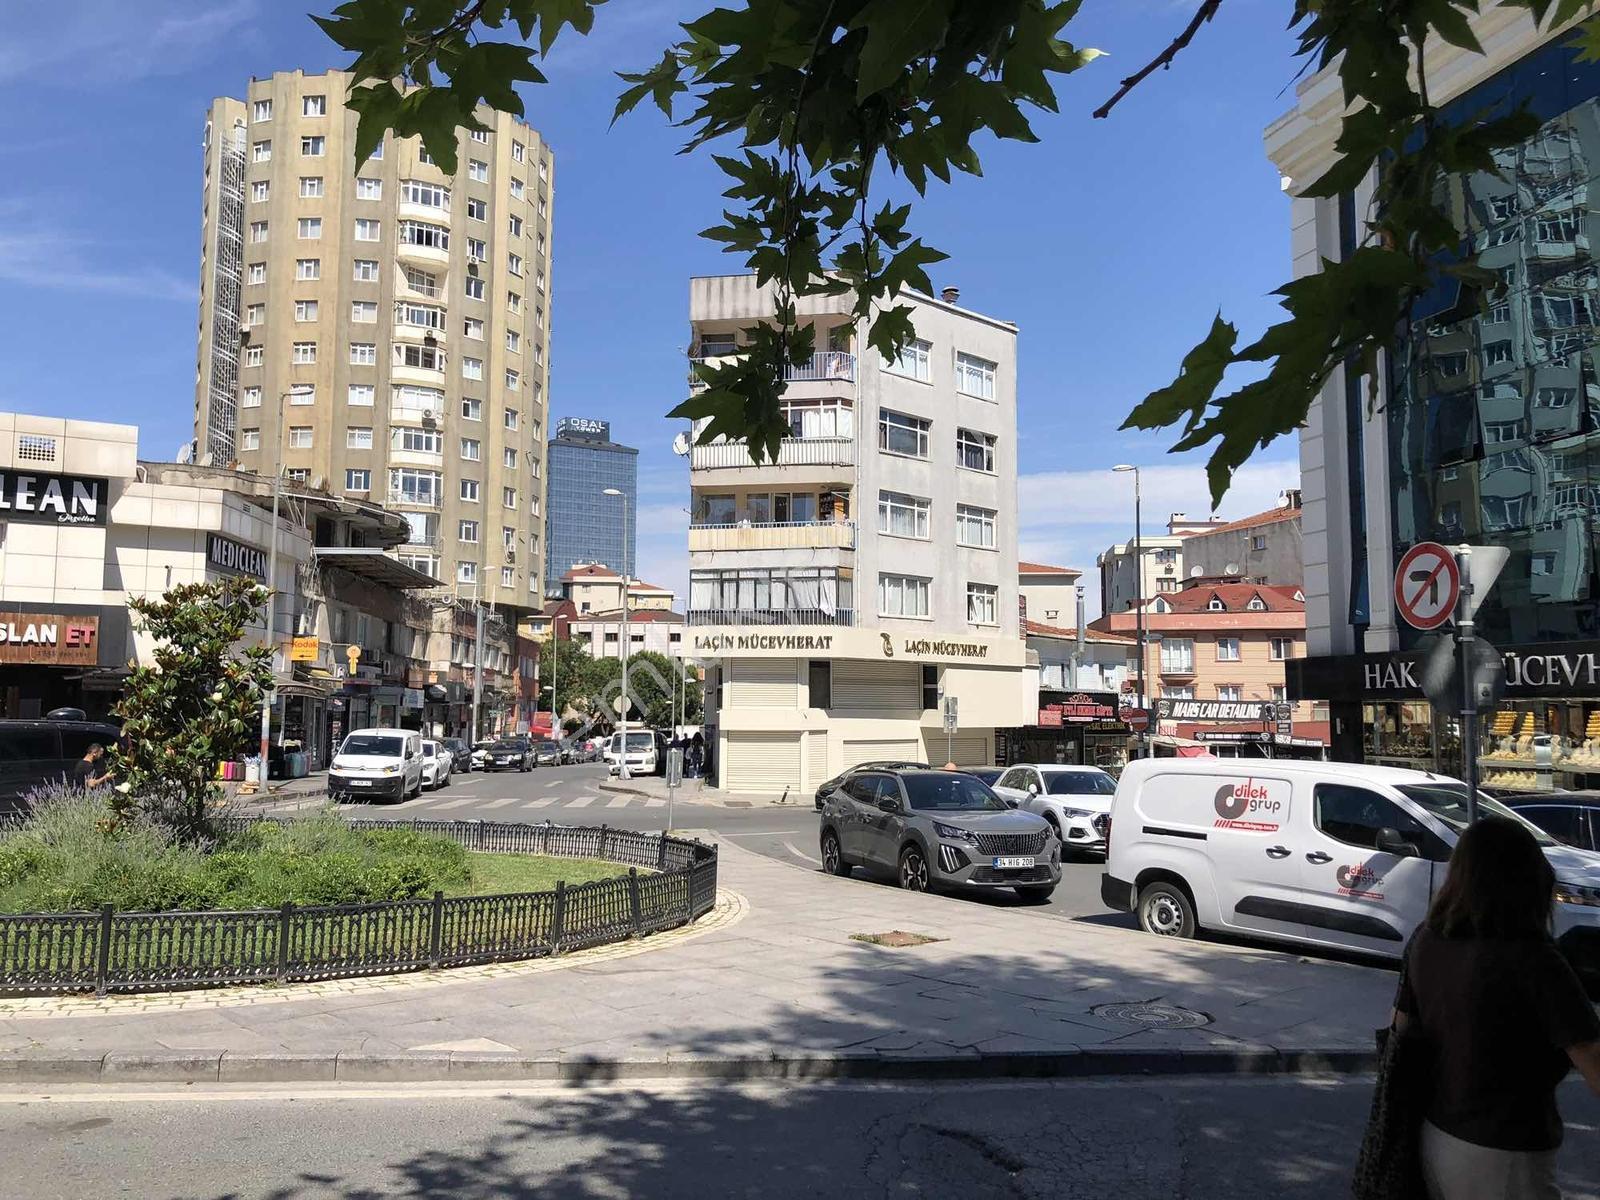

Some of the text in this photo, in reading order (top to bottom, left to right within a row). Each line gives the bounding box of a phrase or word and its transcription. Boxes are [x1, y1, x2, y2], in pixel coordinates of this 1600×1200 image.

[66, 624, 95, 645] ET
[694, 632, 833, 652] LAÇİN MÜCEVHERAT
[904, 639, 988, 657] LAÇİN MÜCEVHERAT
[1364, 661, 1421, 689] HAK
[1172, 702, 1262, 718] MARS CAR DETAILING
[1235, 776, 1268, 799] dilek
[1249, 799, 1281, 813] grup
